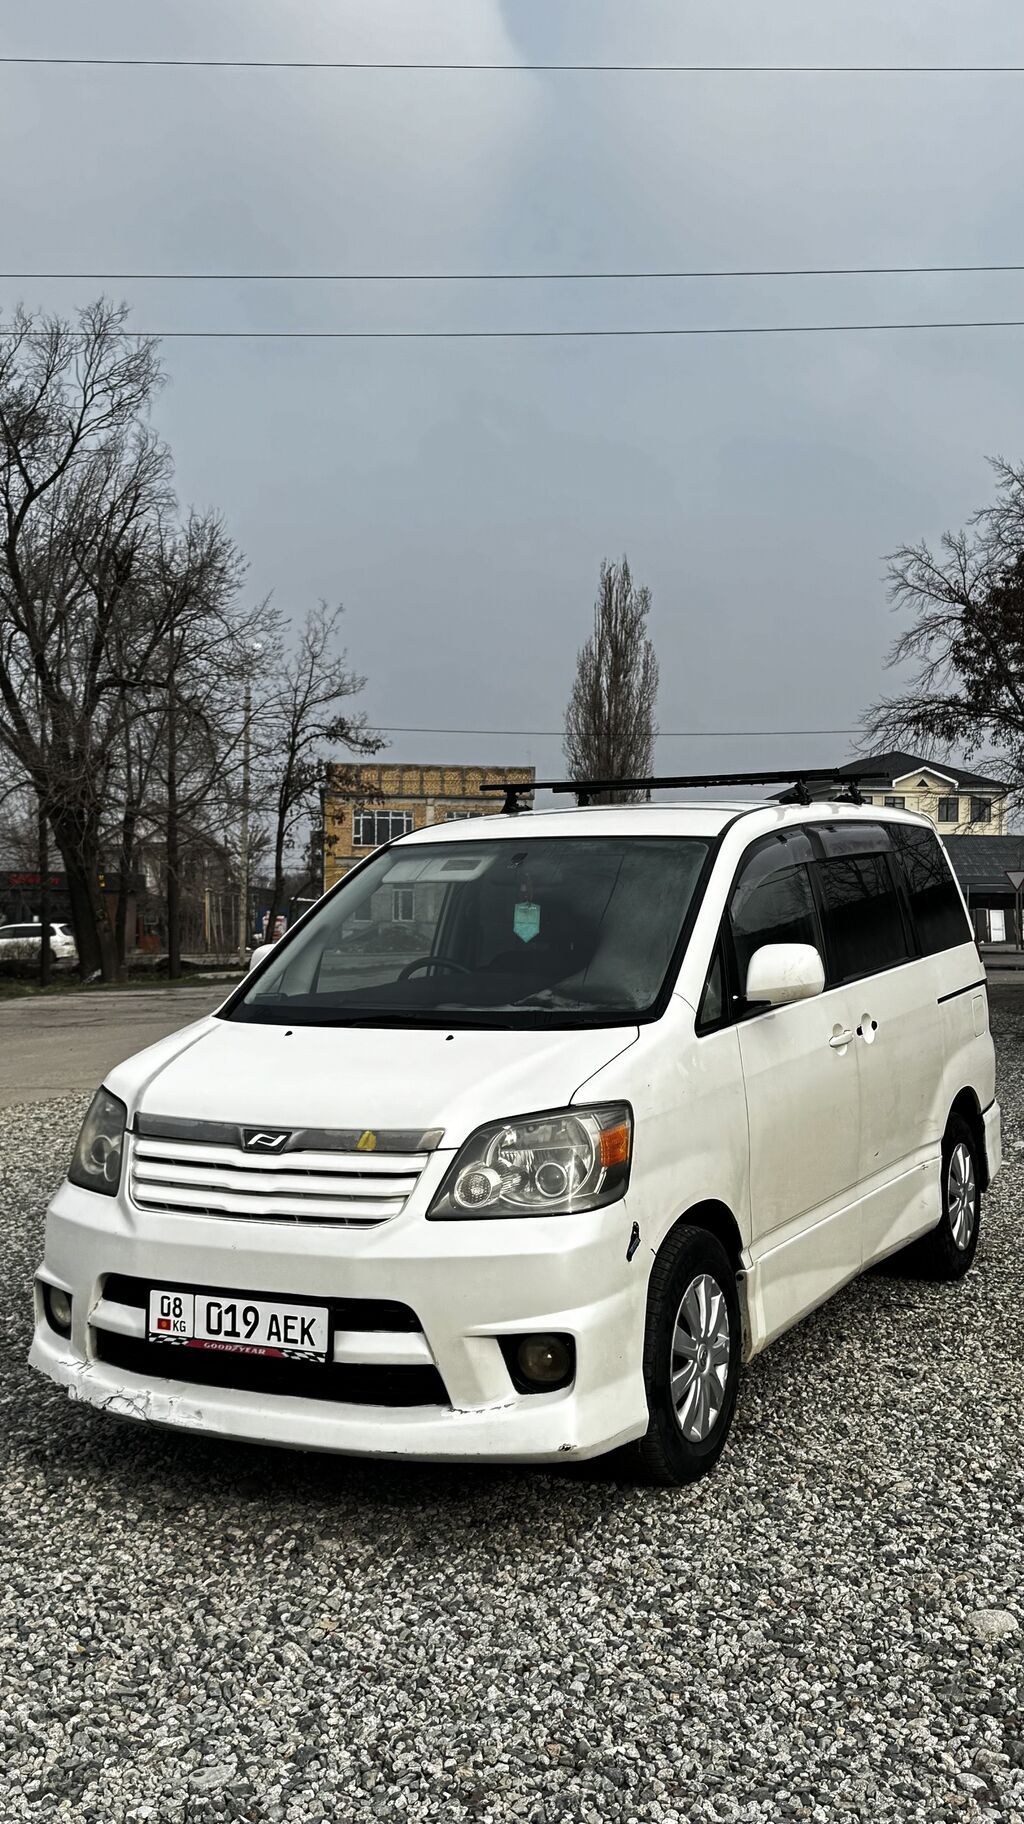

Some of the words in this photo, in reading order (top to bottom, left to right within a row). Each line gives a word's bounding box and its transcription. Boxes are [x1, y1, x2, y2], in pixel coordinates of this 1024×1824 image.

[160, 1295, 183, 1318] 08
[172, 1319, 187, 1333] KG
[206, 1301, 260, 1339] 019
[266, 1313, 317, 1346] AEK
[203, 1341, 267, 1356] GOODYEAR
